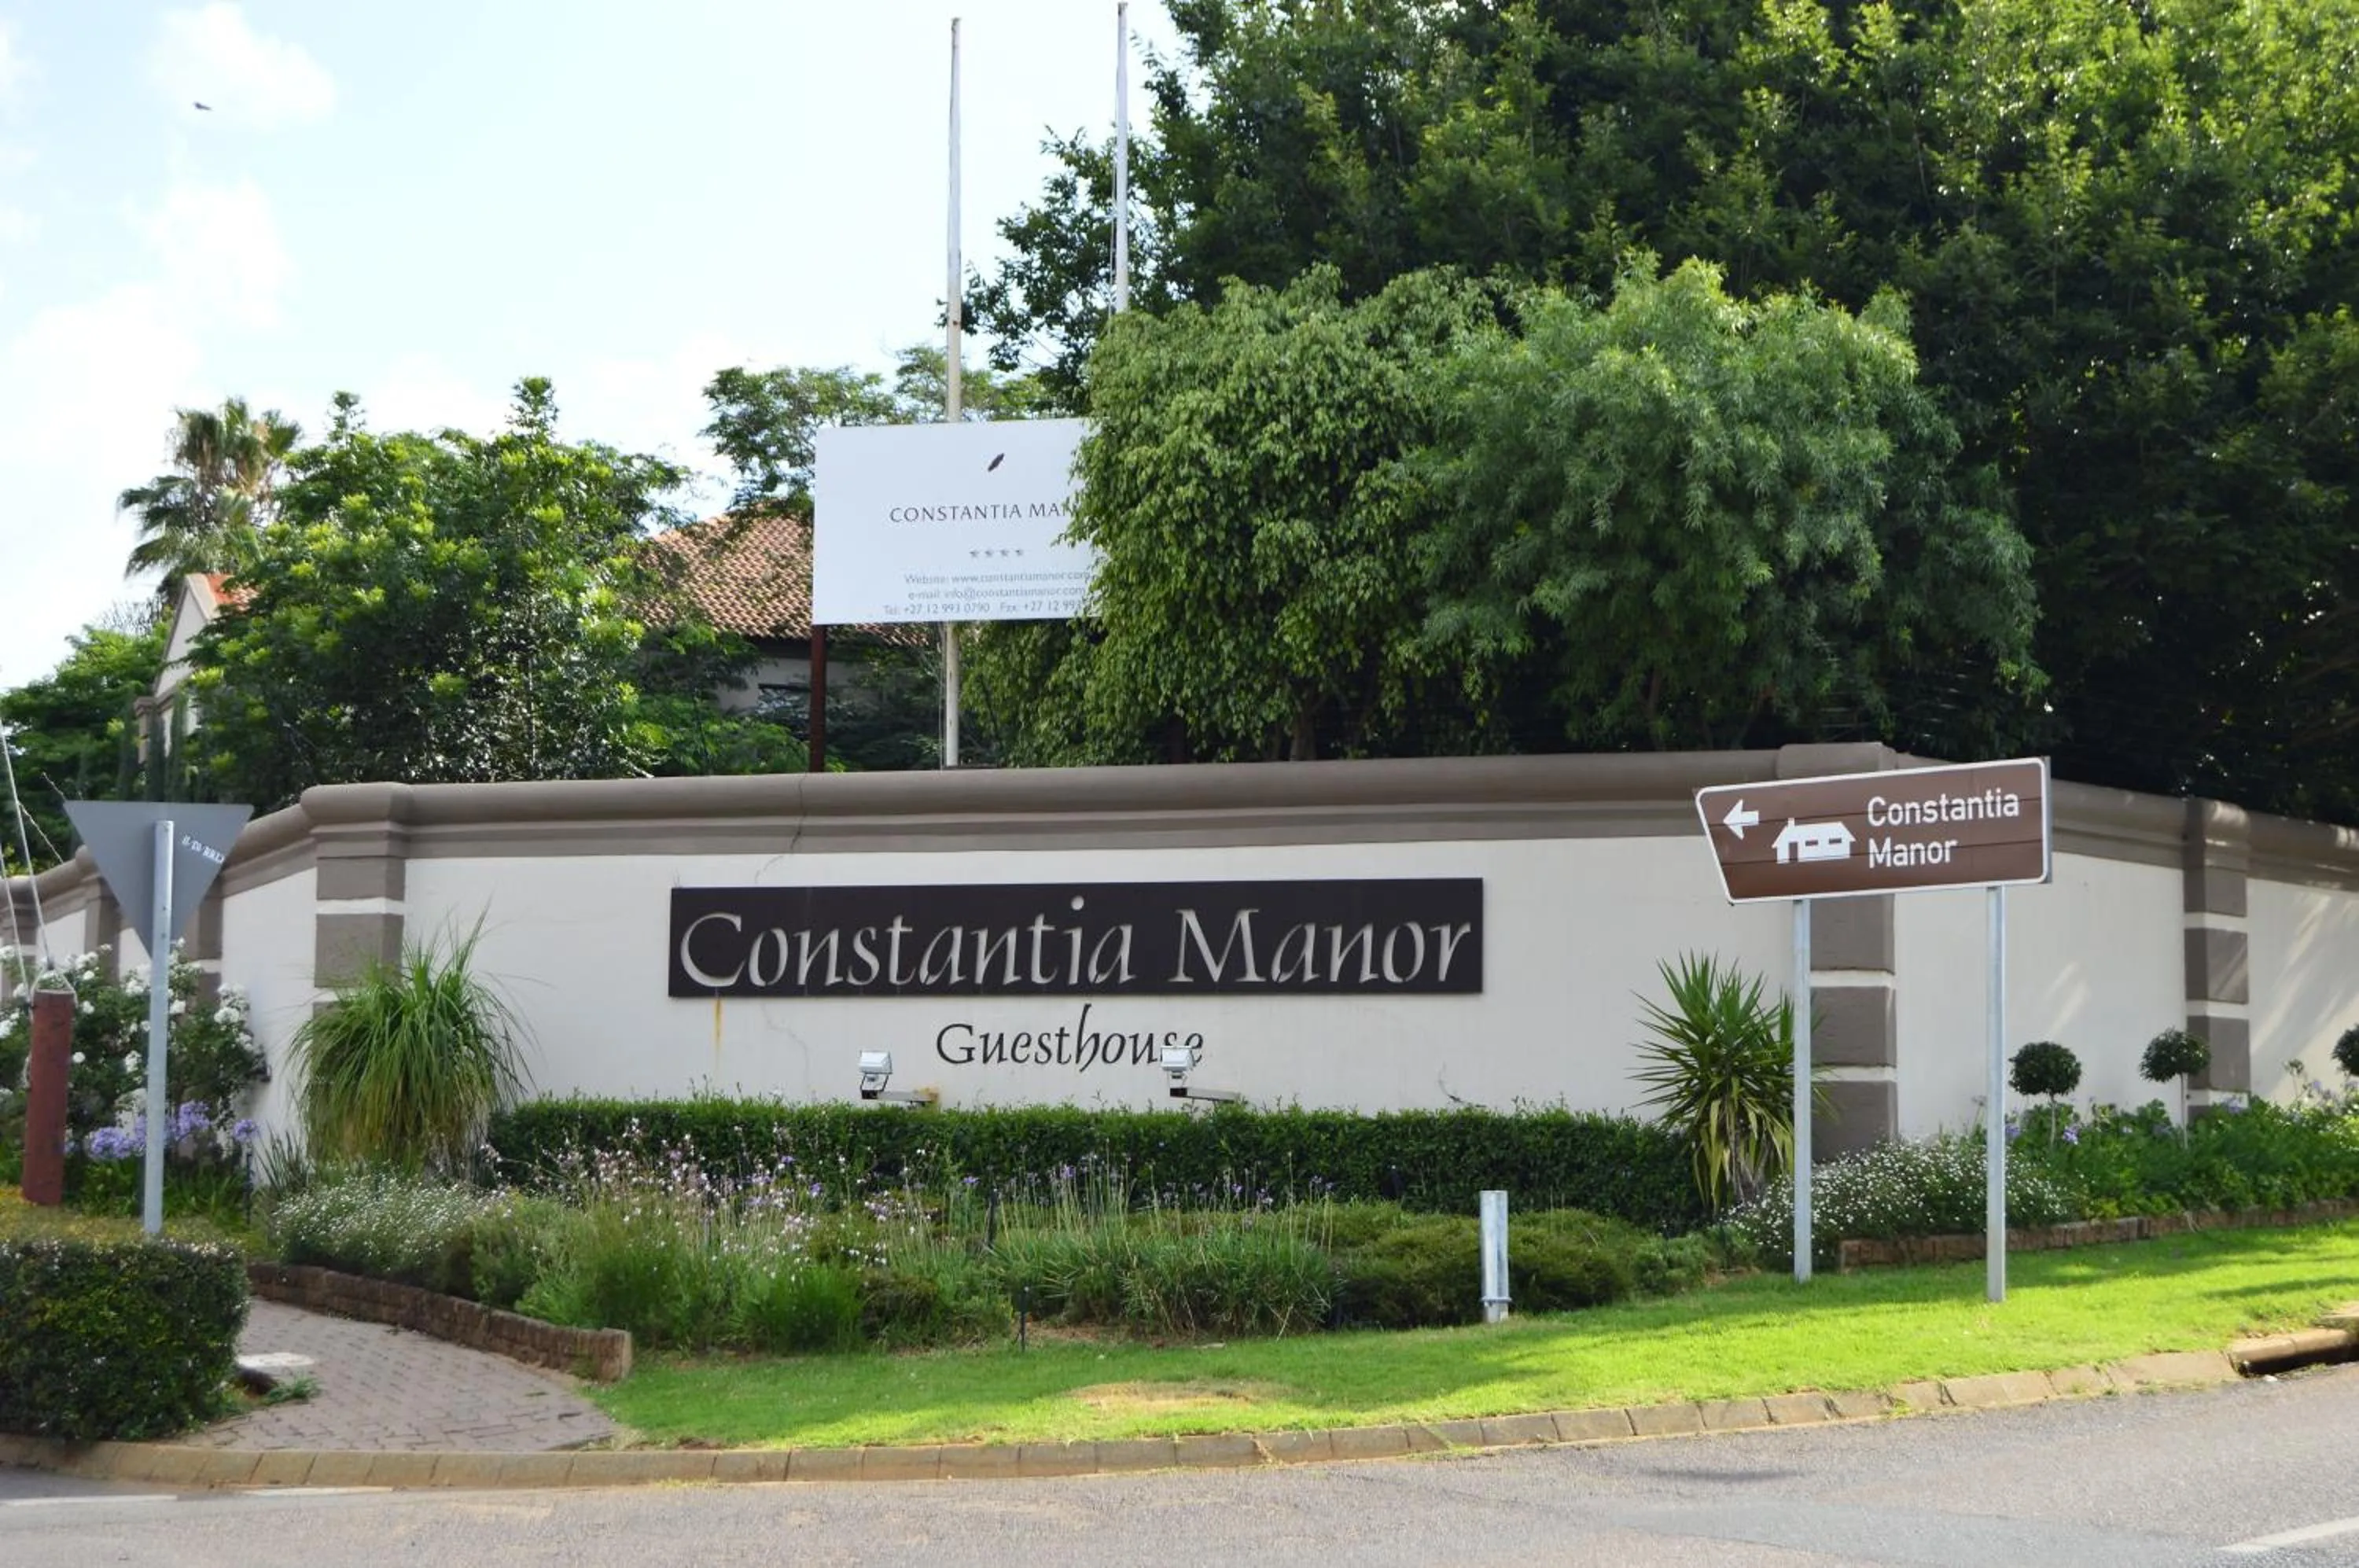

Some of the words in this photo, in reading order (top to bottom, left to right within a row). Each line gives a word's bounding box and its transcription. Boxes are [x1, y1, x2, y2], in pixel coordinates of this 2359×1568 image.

[889, 504, 1021, 523] CONSTANTIA
[1029, 502, 1073, 517] MAN
[904, 603, 922, 614] +27
[927, 603, 938, 613] 12
[1025, 600, 1043, 611] +27
[1048, 600, 1059, 611] 12
[1868, 788, 2019, 827] Constantia
[1868, 837, 1957, 868] Manor
[679, 896, 1137, 988] Constantia
[1168, 908, 1471, 985] Manor
